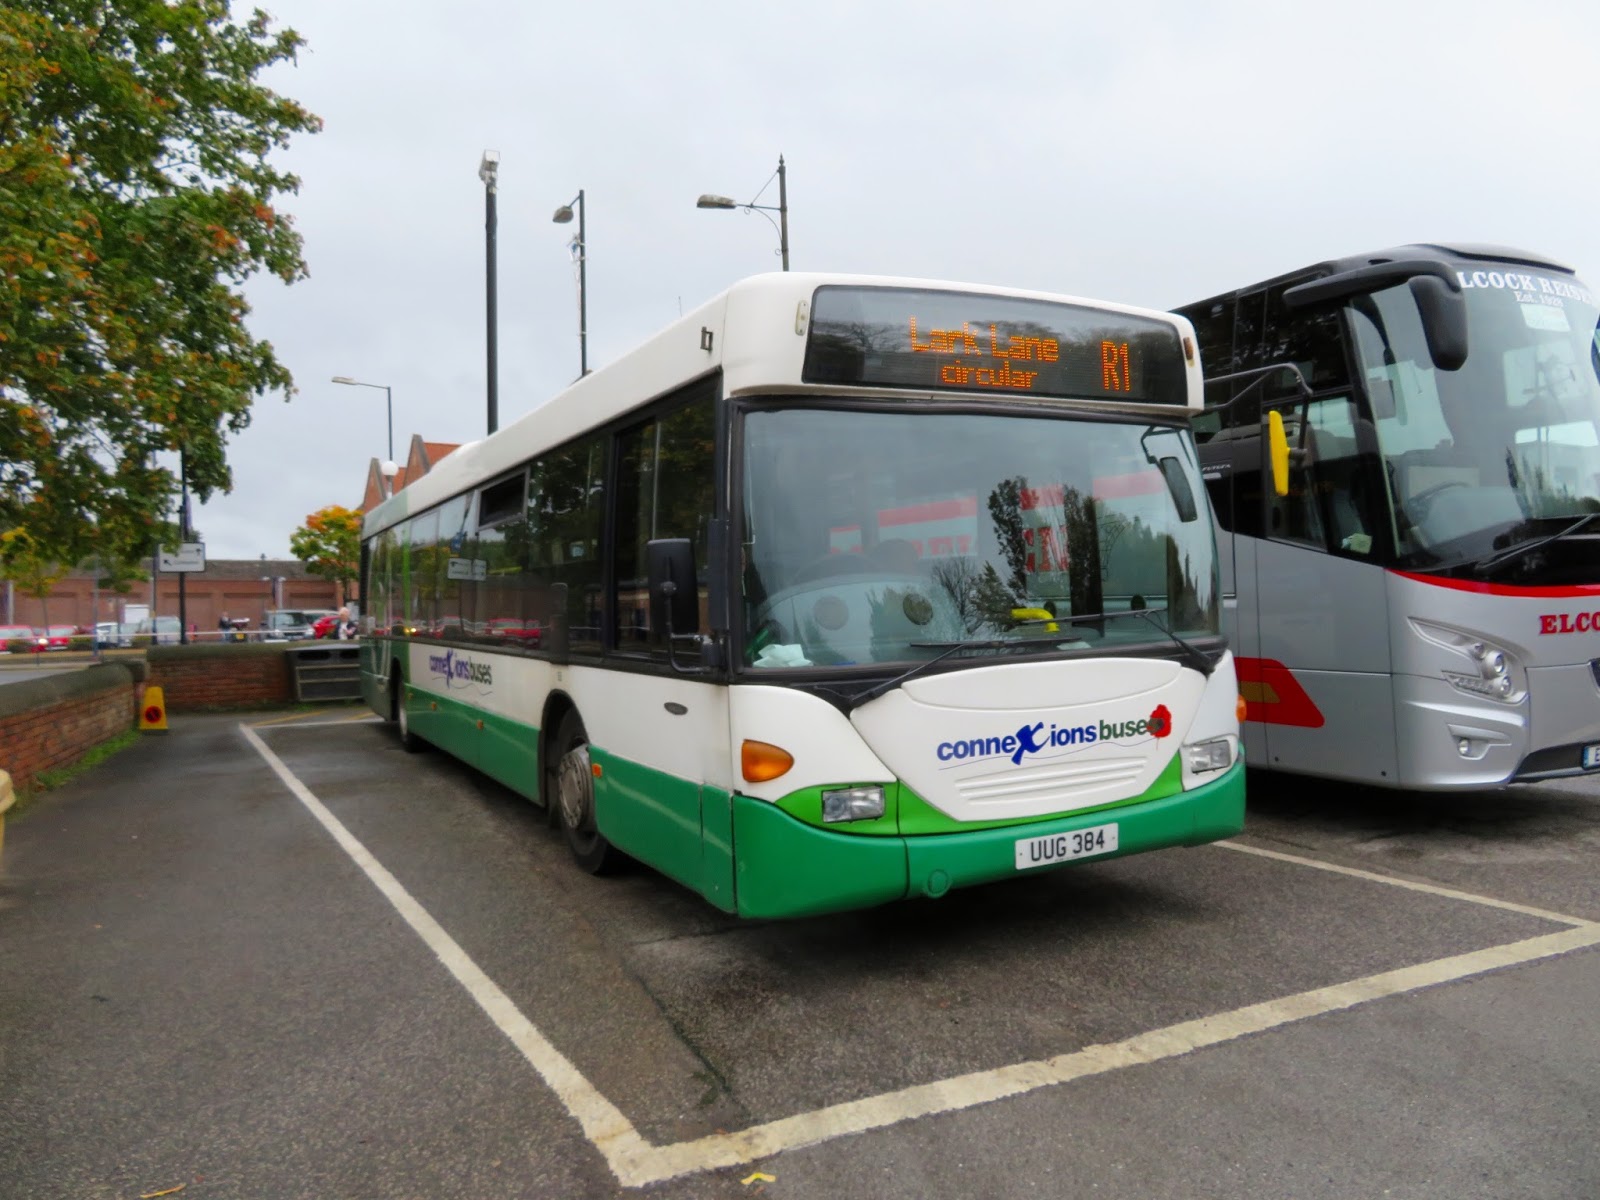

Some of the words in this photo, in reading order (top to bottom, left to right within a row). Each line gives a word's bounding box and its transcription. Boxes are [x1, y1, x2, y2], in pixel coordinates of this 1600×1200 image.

[910, 316, 982, 355] Lark
[990, 323, 1059, 361] Lane
[940, 360, 1038, 388] circular
[1101, 340, 1131, 392] R1
[1030, 836, 1067, 861] UUG
[1072, 829, 1105, 854] 384
